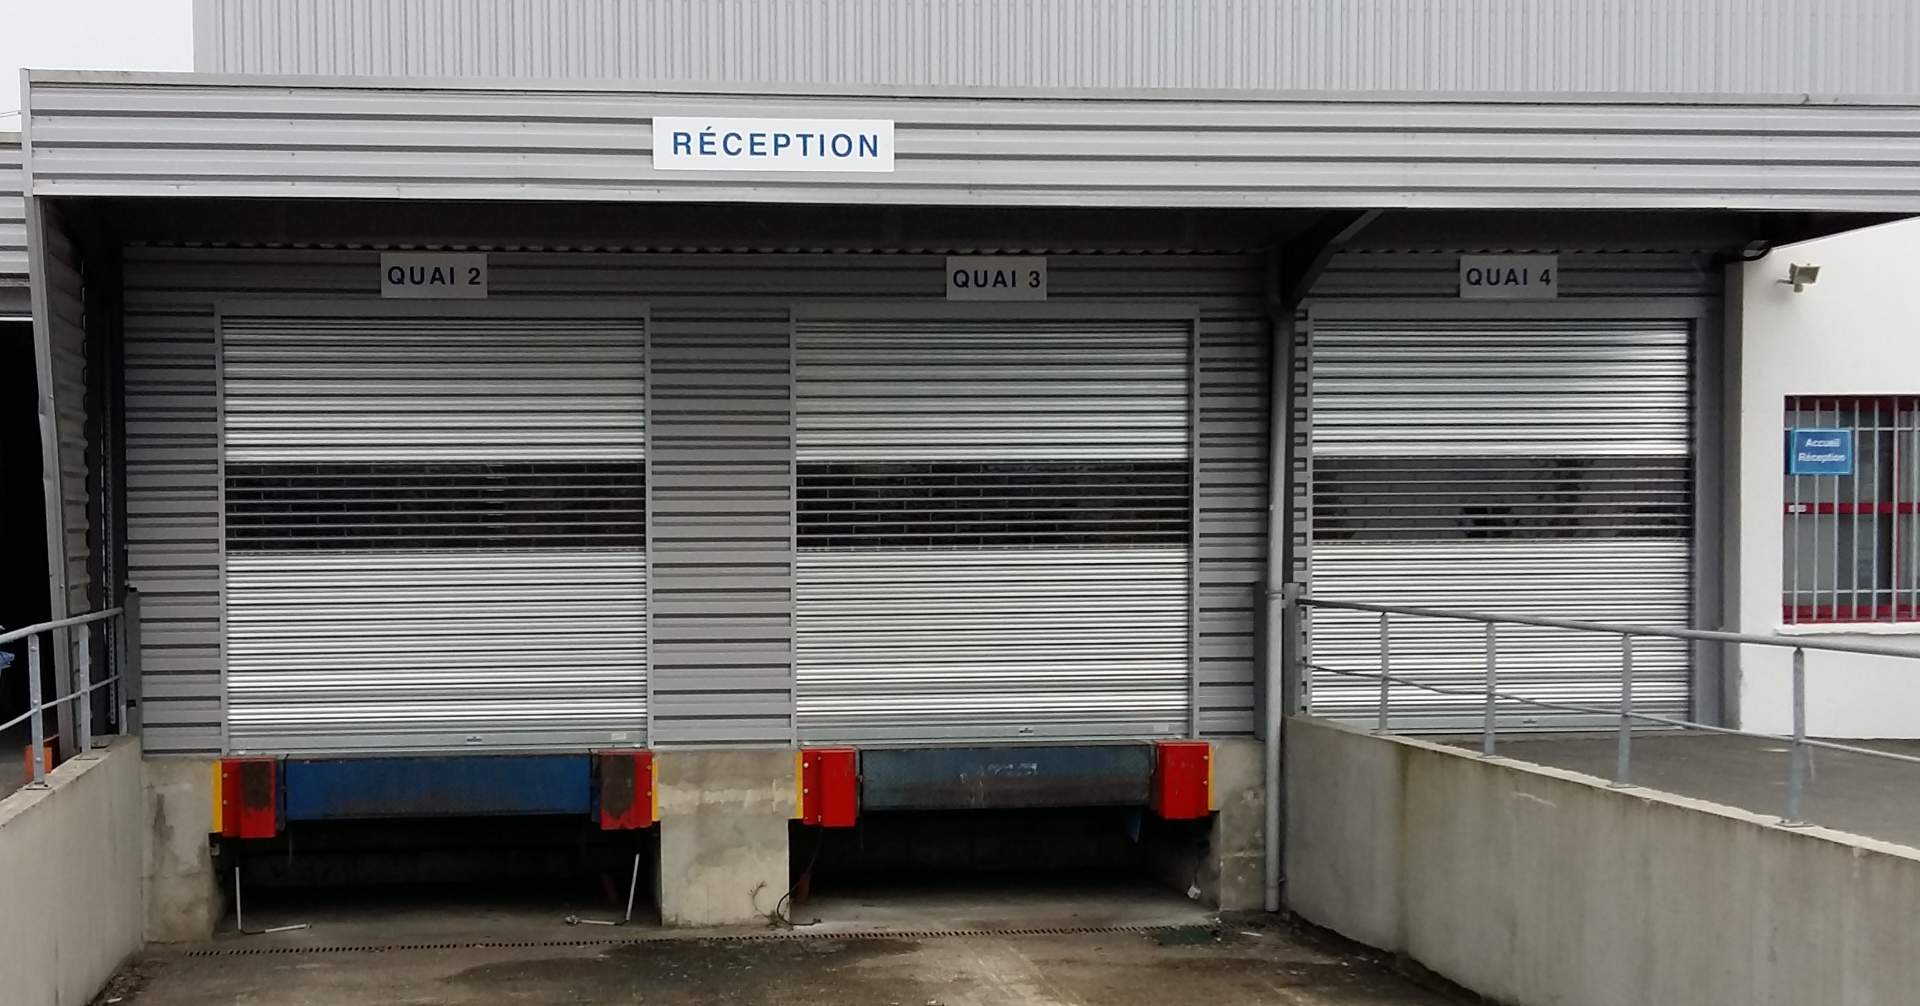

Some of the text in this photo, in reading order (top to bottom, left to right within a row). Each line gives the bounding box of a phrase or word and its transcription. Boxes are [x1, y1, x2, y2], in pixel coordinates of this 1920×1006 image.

[672, 126, 878, 158] RÉCEPTION
[387, 265, 481, 285] QUAI 2
[953, 269, 1041, 288] QUAI 3
[1466, 268, 1552, 286] QUAI 4
[1805, 438, 1841, 447] Accueil
[1798, 452, 1846, 463] Réception
